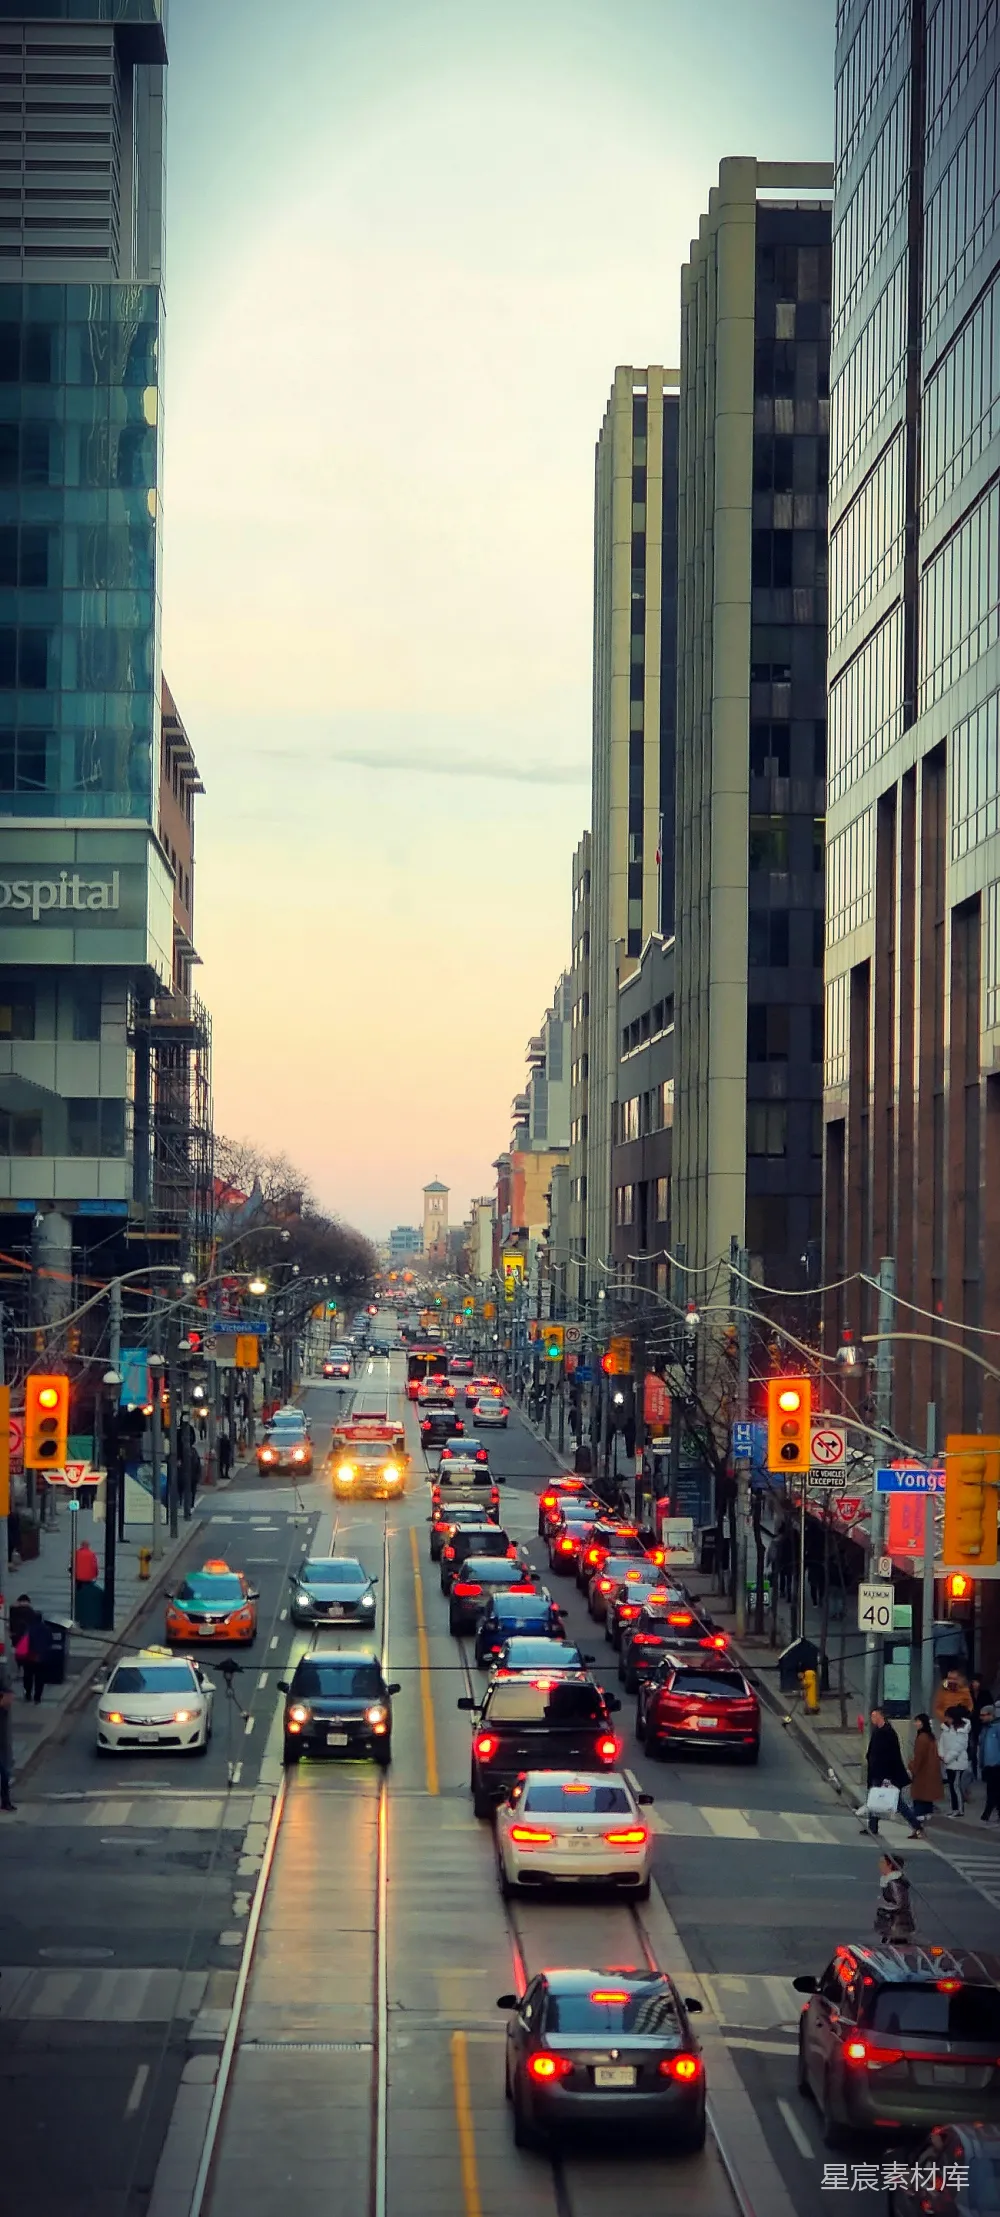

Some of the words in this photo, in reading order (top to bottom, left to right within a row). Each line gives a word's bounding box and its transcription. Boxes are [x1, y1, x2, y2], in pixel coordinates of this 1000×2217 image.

[220, 1323, 252, 1332] Victoria
[737, 1425, 750, 1441] H
[820, 1470, 845, 1478] VEHICLES
[895, 1471, 946, 1491] Yonge
[863, 1606, 890, 1625] 40
